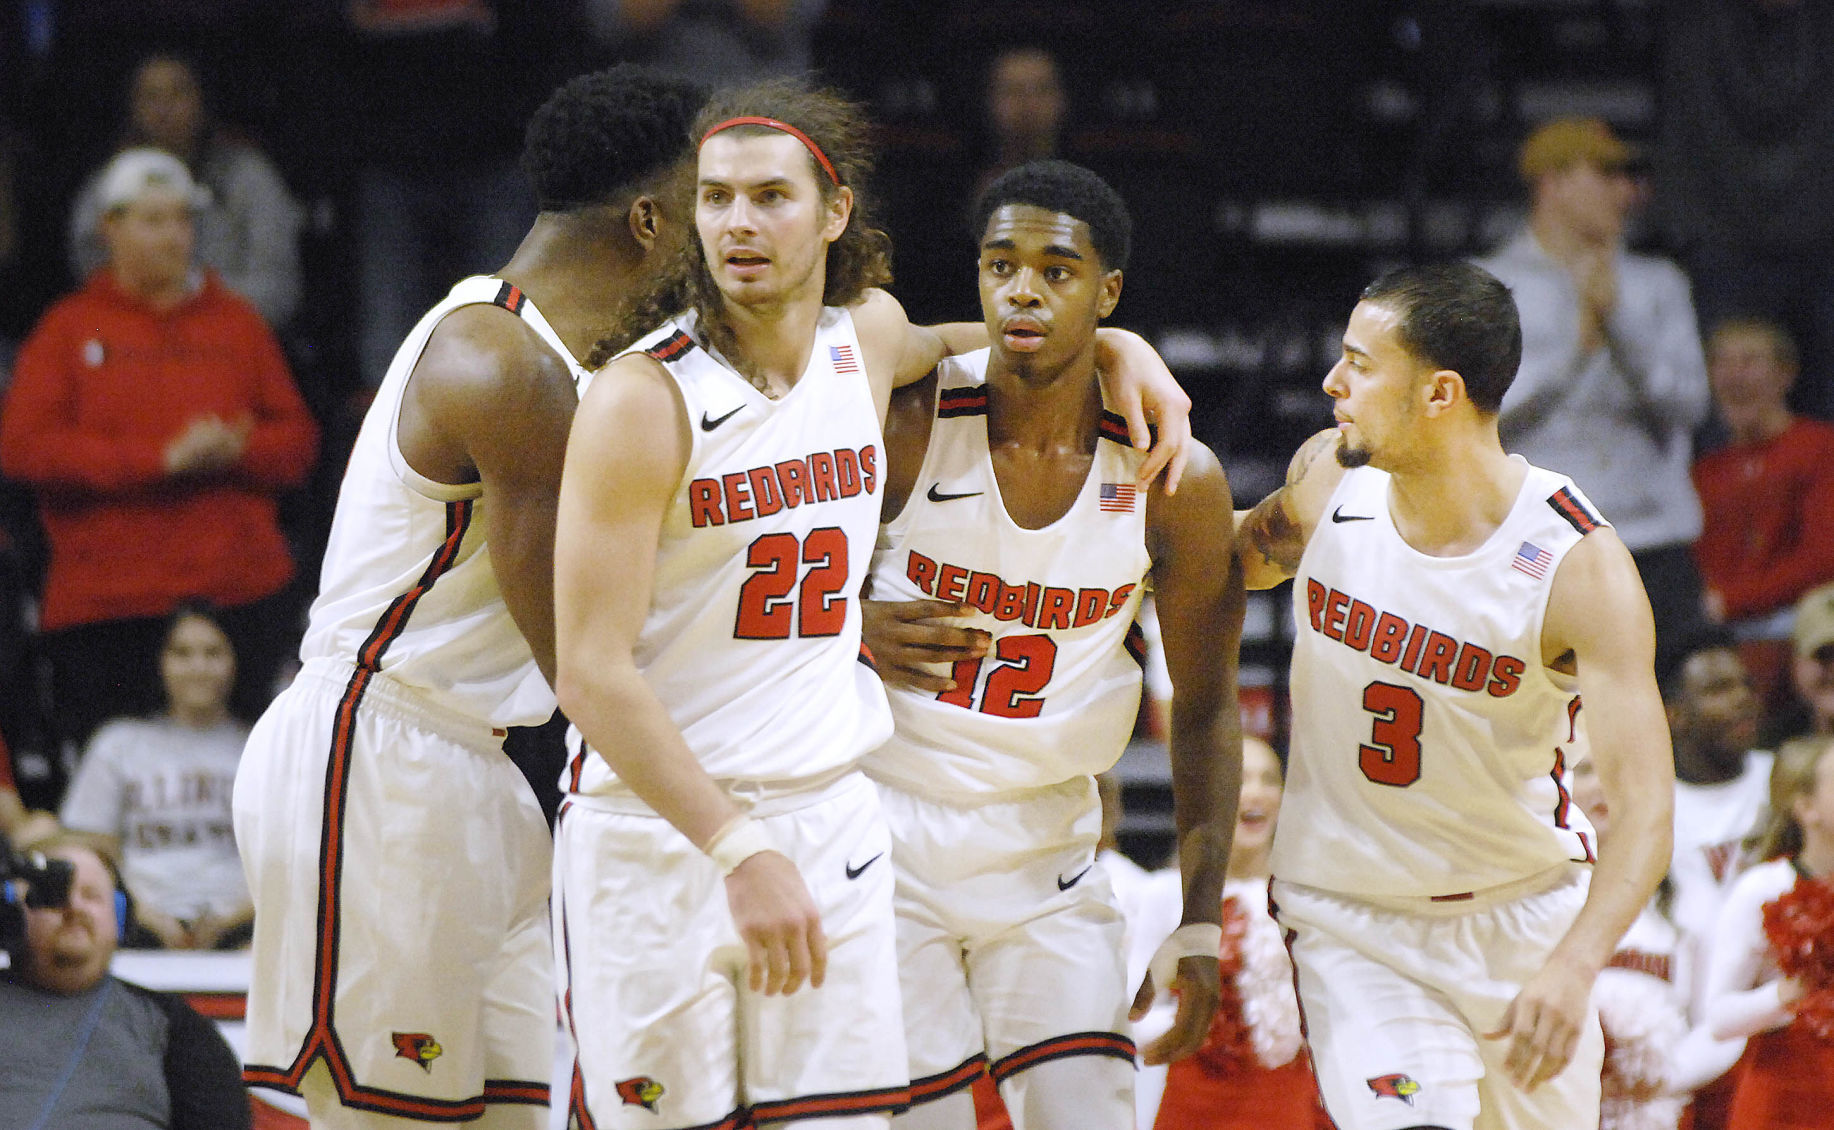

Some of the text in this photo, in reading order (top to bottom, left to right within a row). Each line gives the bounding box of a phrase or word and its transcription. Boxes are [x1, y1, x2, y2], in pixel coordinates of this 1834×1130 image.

[689, 445, 876, 528] REDBIRDS
[733, 526, 848, 639] 22
[907, 549, 1136, 629] REDBIRDS
[1307, 577, 1526, 697] REDBIRDS
[1359, 681, 1424, 787] 3
